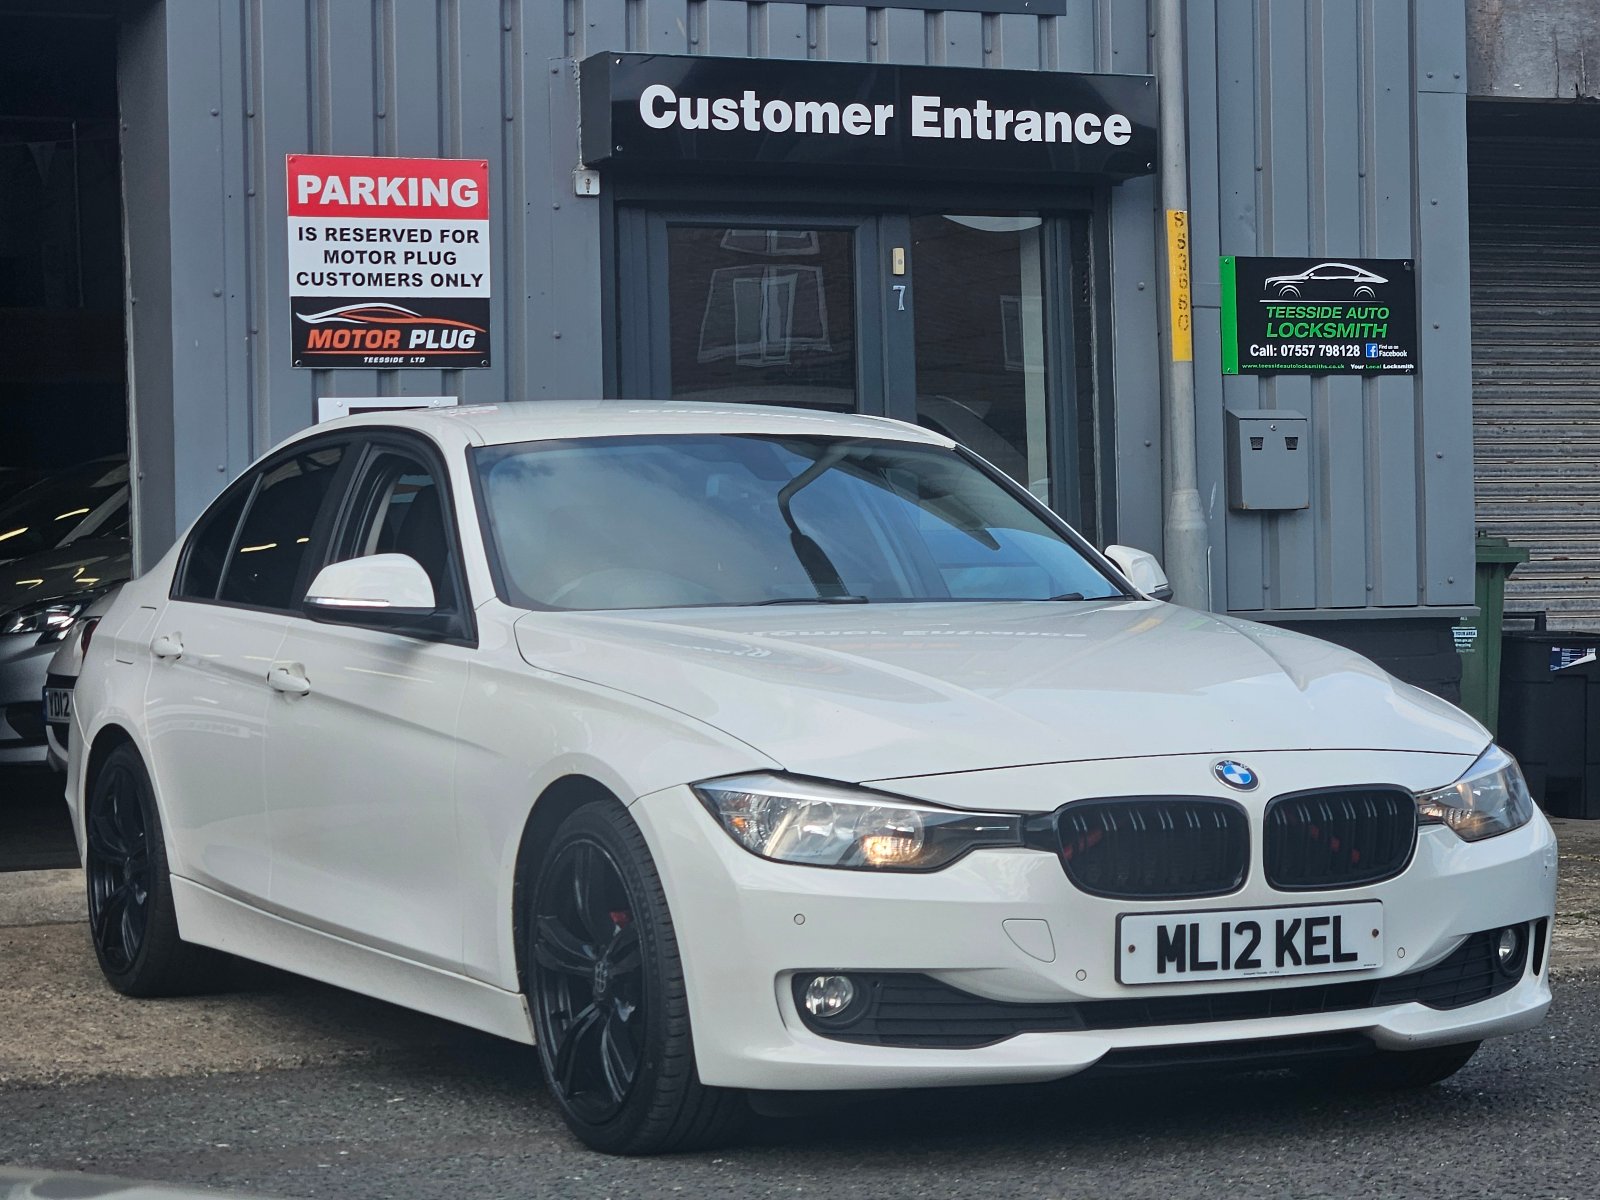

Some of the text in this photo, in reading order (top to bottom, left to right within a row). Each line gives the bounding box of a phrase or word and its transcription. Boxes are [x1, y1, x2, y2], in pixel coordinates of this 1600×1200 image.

[639, 84, 1133, 146] Customer Entrance
[297, 174, 479, 207] PARKING
[298, 226, 479, 244] IS RESERVED FOR
[324, 250, 457, 265] MOTOR PLUG
[296, 272, 483, 288] CUSTOMERS ONLY
[892, 285, 906, 311] 7
[1266, 306, 1390, 320] TEESSIDE AUTO
[307, 329, 476, 349] MOTOR PLUG
[1266, 322, 1388, 339] LOCKSMITH
[1250, 344, 1361, 357] Call: 07557 798128
[1378, 350, 1408, 358] Facebook
[363, 356, 426, 364] TEESSIDE LTD
[1157, 914, 1358, 974] ML12 KEL
